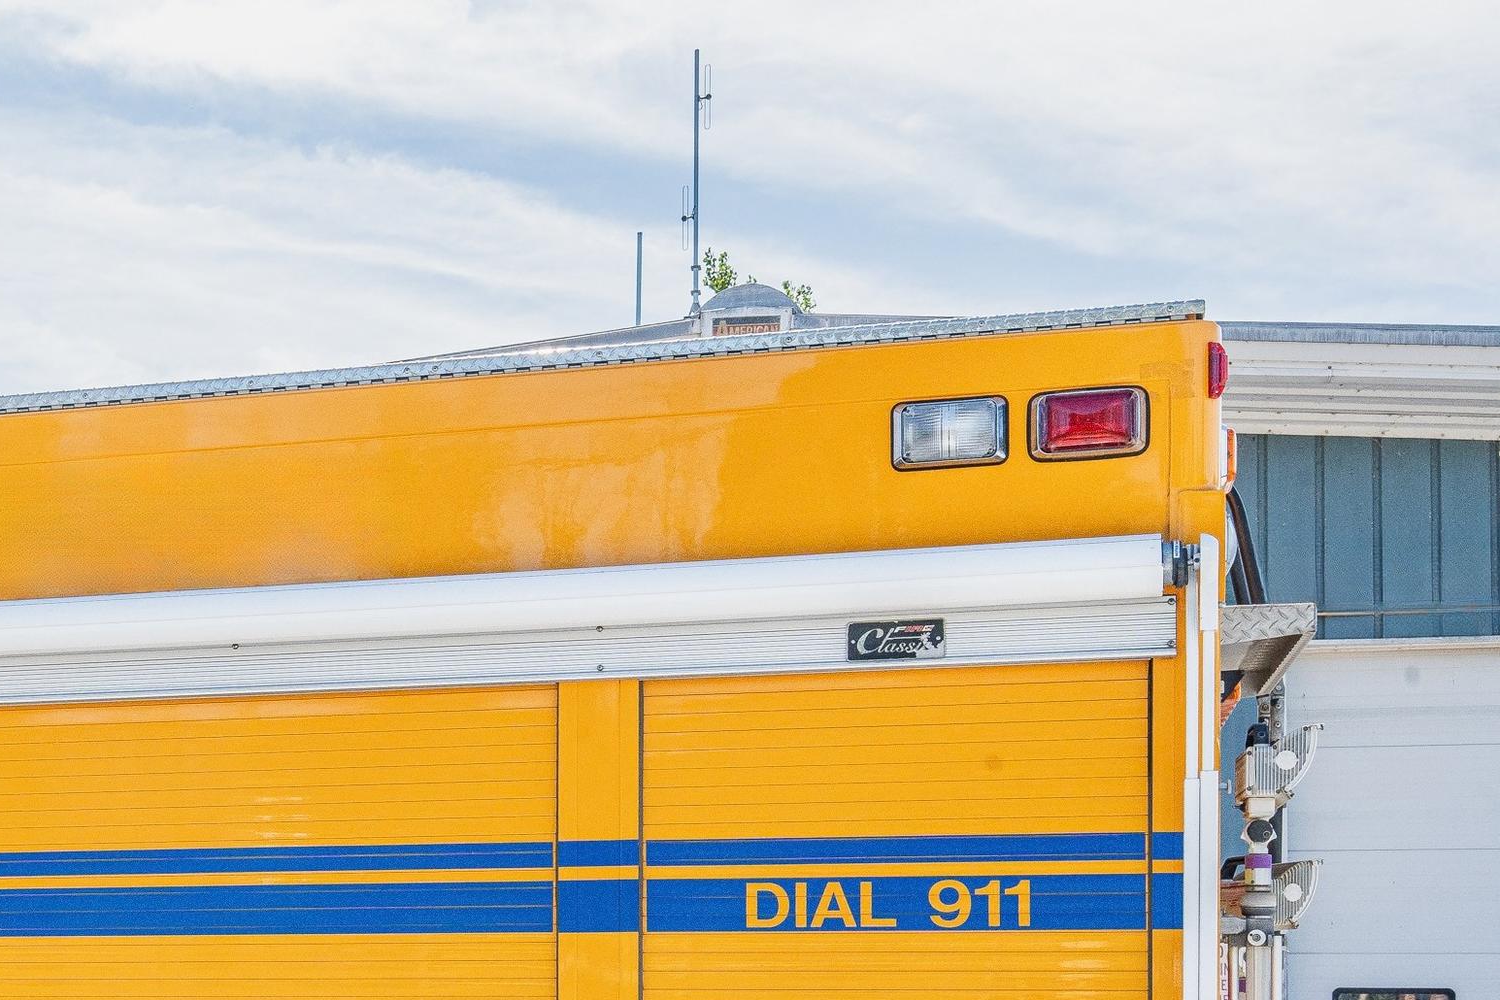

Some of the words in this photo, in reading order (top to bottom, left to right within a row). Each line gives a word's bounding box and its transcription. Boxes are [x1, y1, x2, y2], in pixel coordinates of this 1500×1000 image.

[894, 625, 935, 633] FIRE
[745, 881, 897, 928] DIAL
[928, 879, 1031, 928] 911
